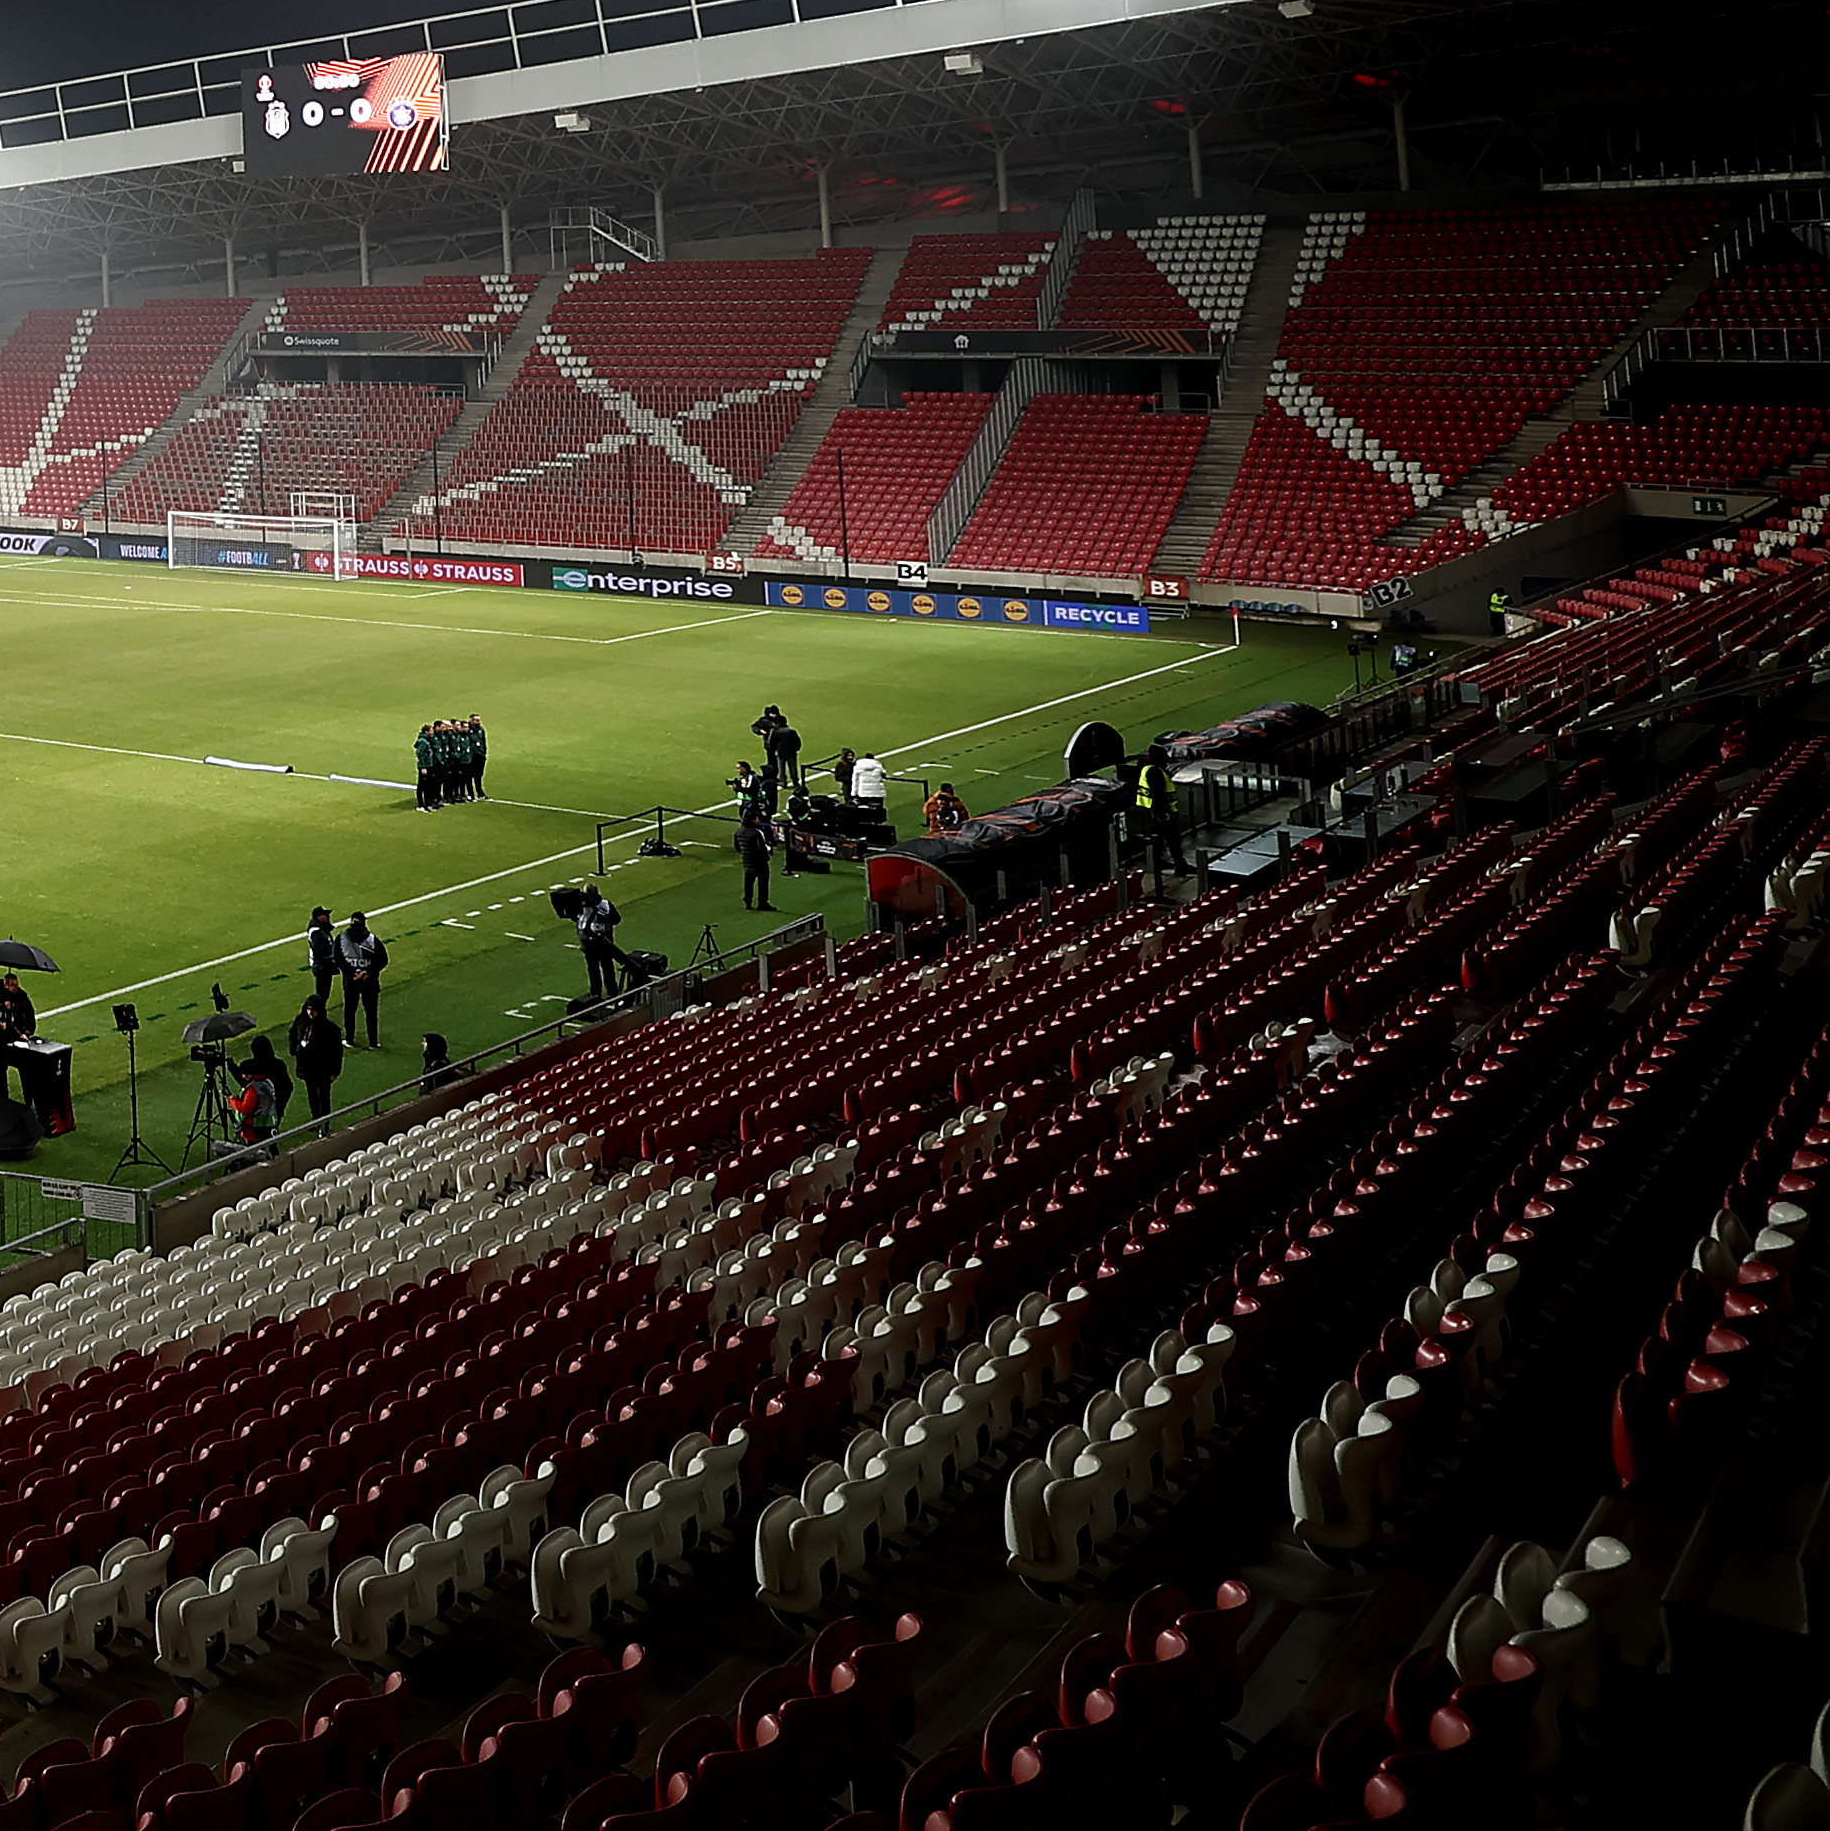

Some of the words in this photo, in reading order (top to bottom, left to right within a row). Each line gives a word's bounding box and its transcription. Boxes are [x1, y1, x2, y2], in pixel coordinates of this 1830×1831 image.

[294, 336, 339, 347] Swissquote
[62, 518, 79, 530] B7
[120, 544, 160, 559] WELCOME
[217, 550, 269, 566] #FOOTBALL
[433, 562, 515, 582] STRAUSS
[898, 564, 927, 579] B4
[563, 571, 733, 598] enterprise
[1151, 580, 1179, 596] B3
[1372, 577, 1413, 606] B2
[1055, 607, 1139, 625] RECYCLE
